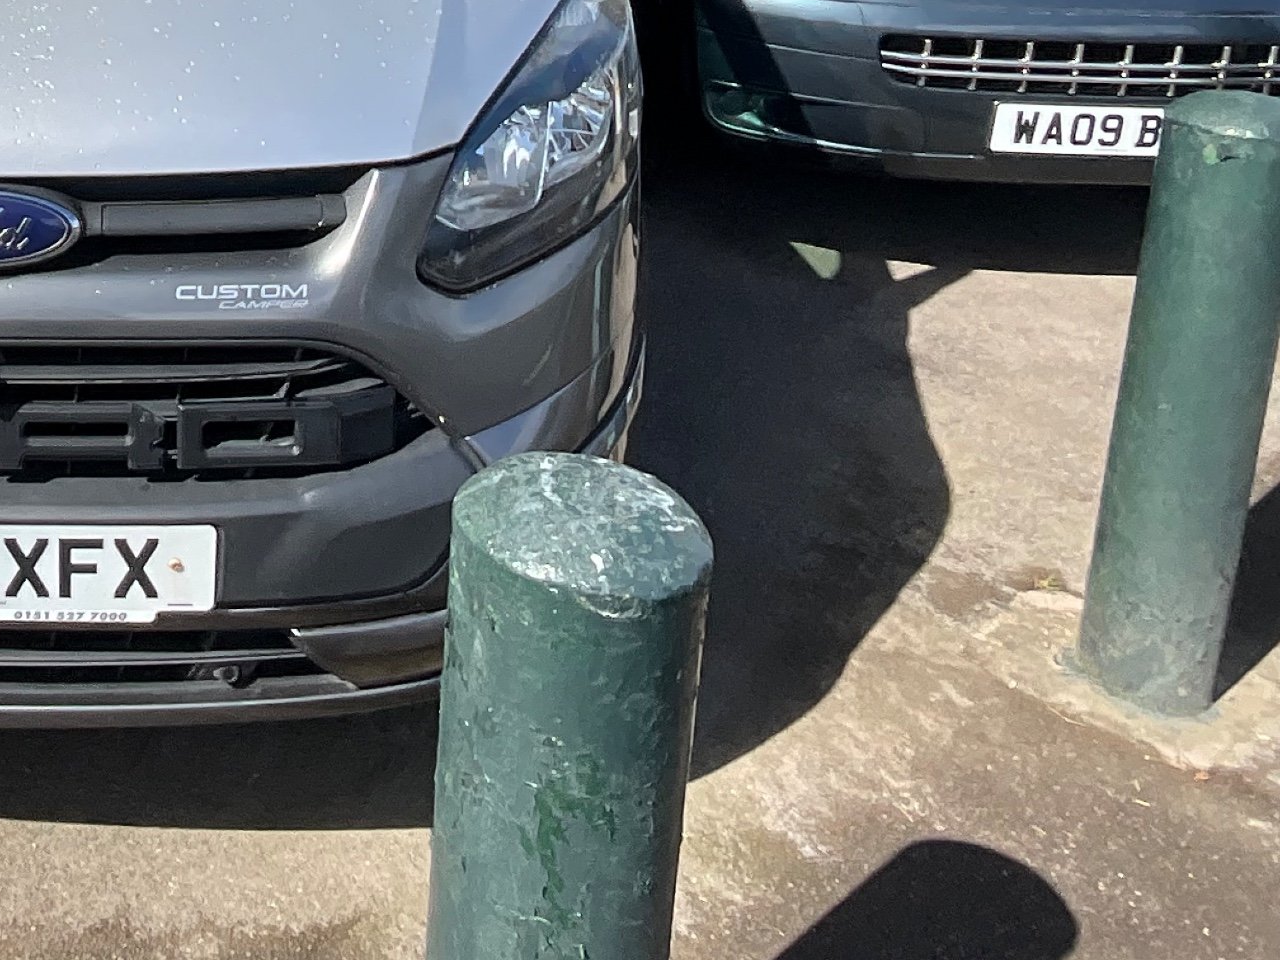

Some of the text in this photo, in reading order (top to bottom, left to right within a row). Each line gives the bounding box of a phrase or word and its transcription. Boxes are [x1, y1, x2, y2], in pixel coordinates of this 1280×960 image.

[1013, 110, 1124, 147] WA09
[175, 283, 309, 301] CUSTOM
[218, 298, 309, 311] CAMPER
[5, 537, 160, 600] XFX
[90, 611, 128, 622] 7000
